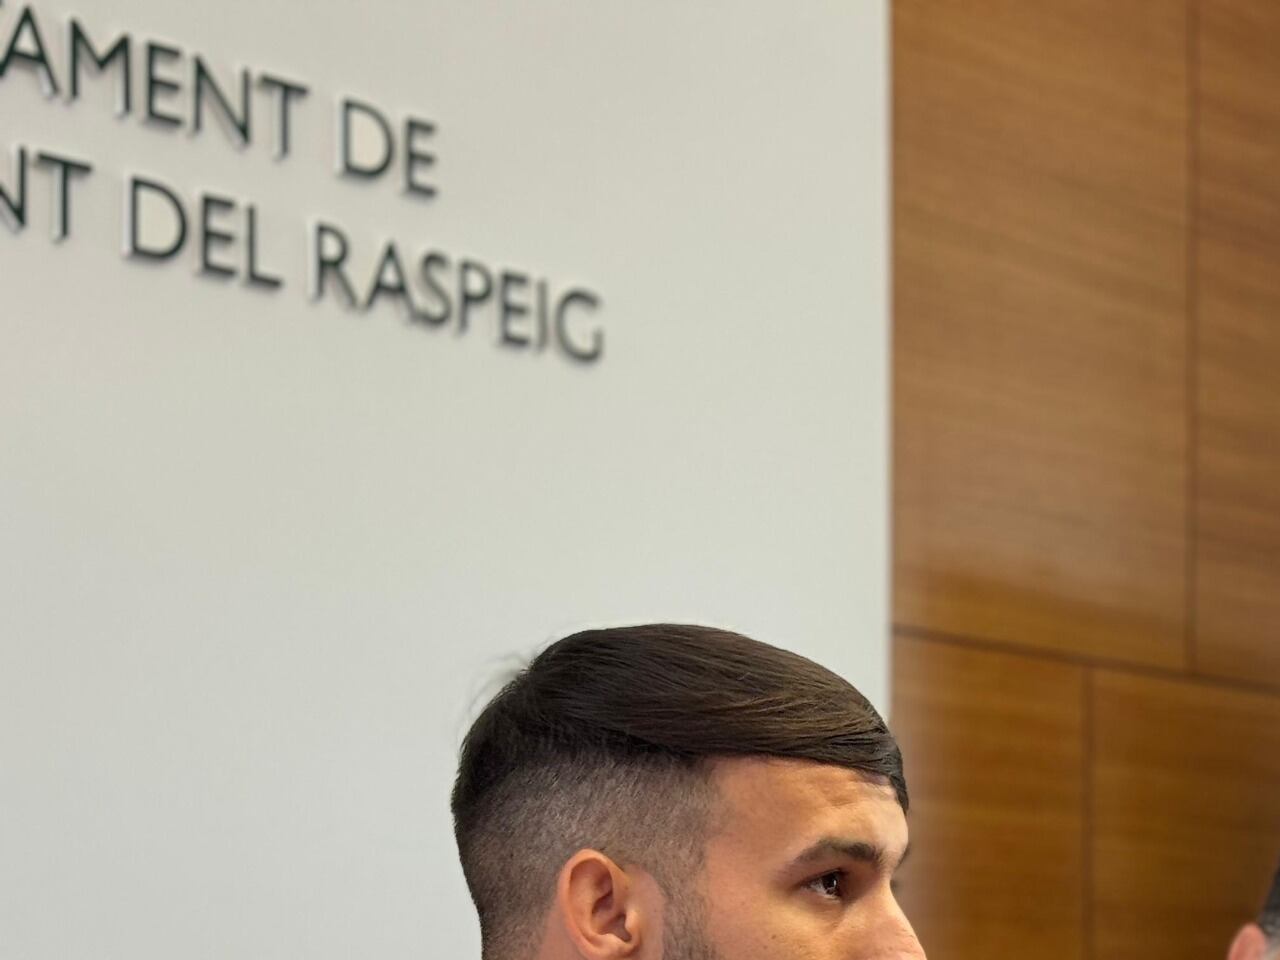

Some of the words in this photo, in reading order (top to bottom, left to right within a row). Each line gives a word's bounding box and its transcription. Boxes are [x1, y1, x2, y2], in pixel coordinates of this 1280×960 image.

[337, 98, 438, 199] DE
[127, 175, 283, 290] DEL
[312, 219, 604, 364] RASPEIG
